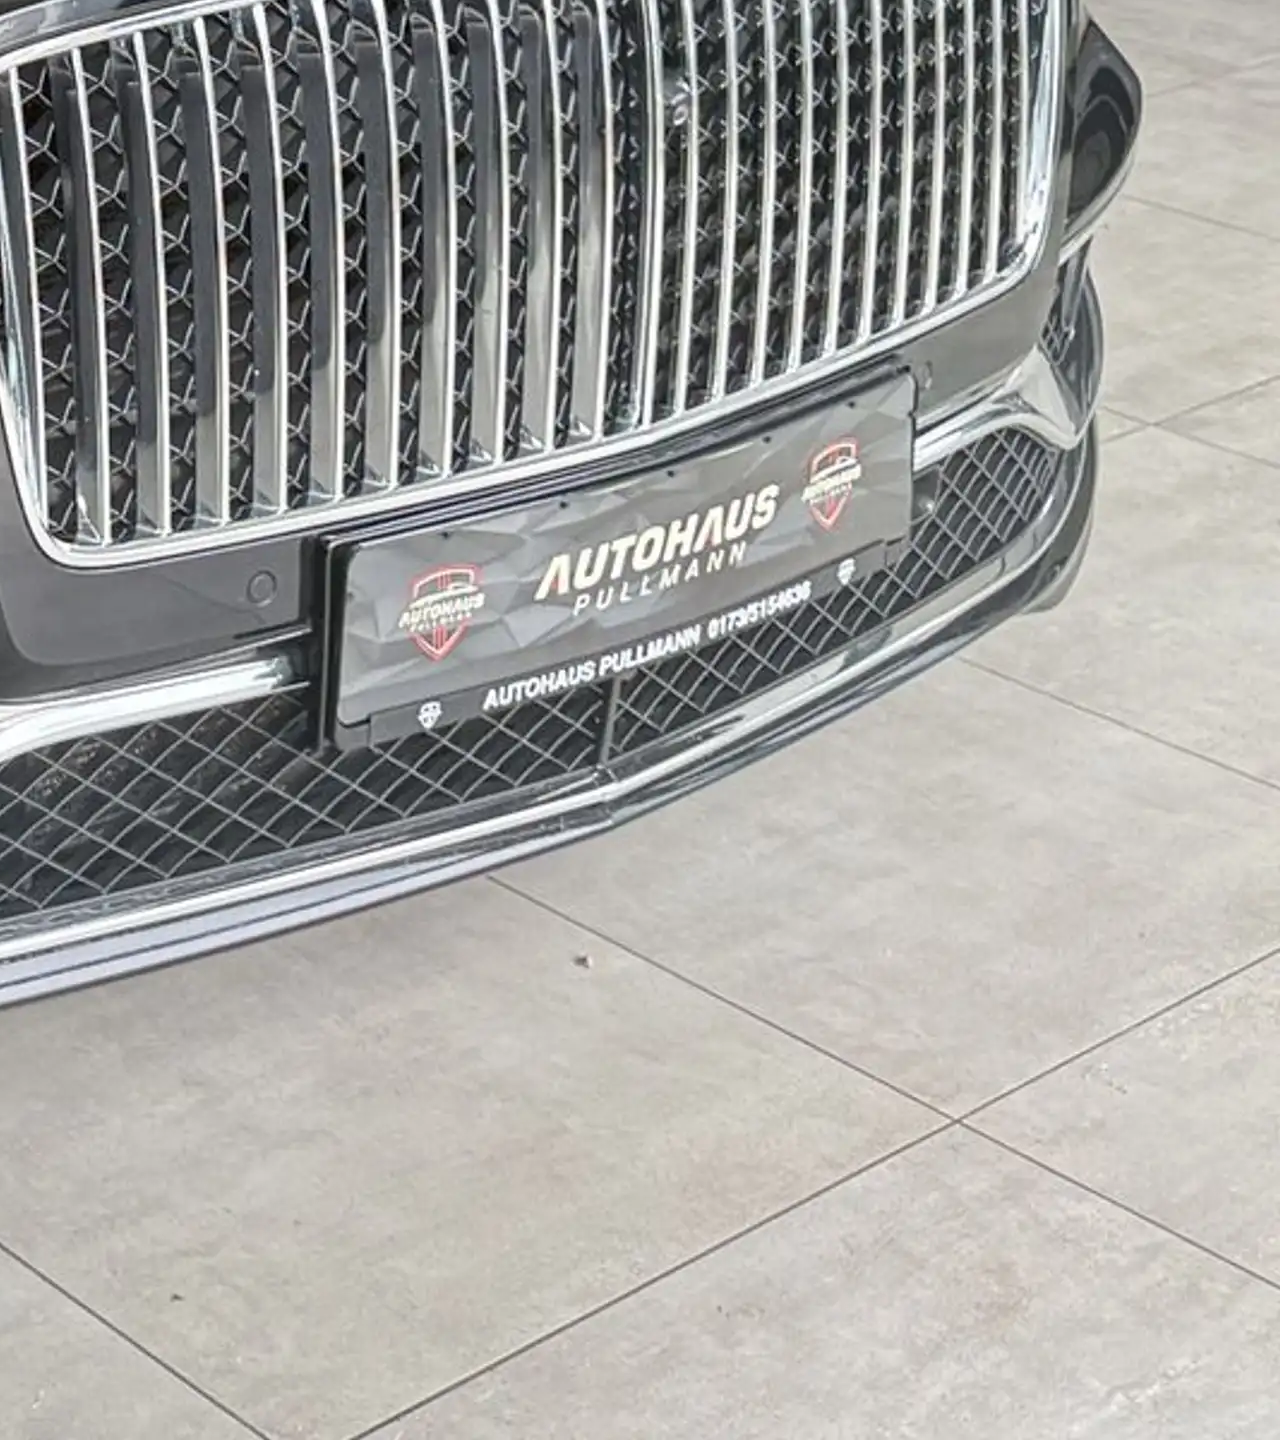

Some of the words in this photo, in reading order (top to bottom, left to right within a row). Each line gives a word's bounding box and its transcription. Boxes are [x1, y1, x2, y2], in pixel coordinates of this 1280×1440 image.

[533, 483, 780, 601] AUTOHAUS
[573, 540, 747, 617] PULLMANN
[482, 662, 597, 710] AUTOHAUS
[598, 623, 702, 676] PULLMANN
